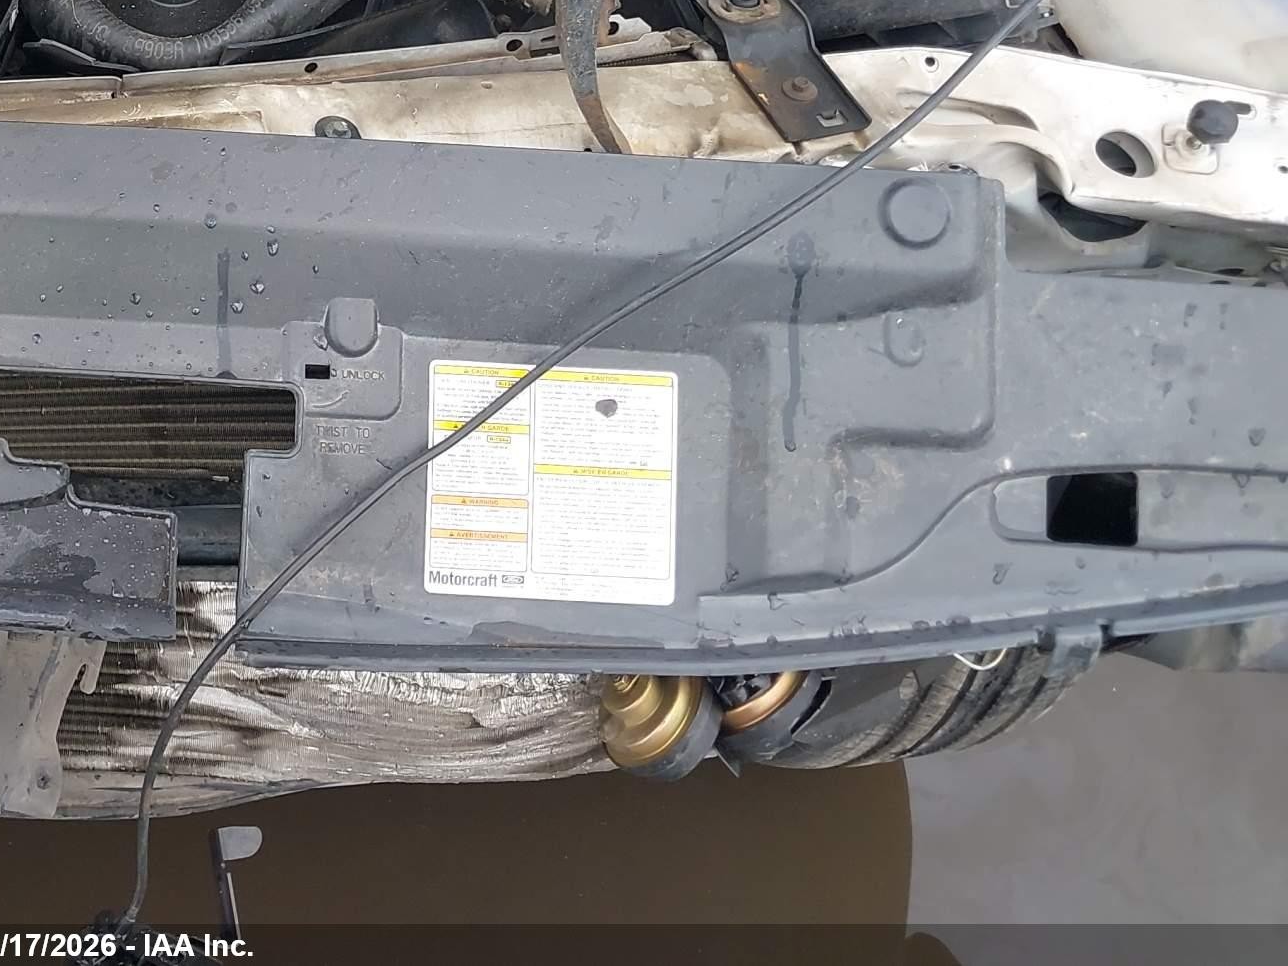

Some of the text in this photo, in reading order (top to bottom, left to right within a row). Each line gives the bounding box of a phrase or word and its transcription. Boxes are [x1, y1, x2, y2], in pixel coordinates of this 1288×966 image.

[341, 370, 385, 381] UNLOCK
[315, 425, 370, 439] TWIST TO
[319, 441, 366, 455] REMOVE
[469, 498, 499, 506] WARNING
[428, 570, 498, 587] Motorcraft
